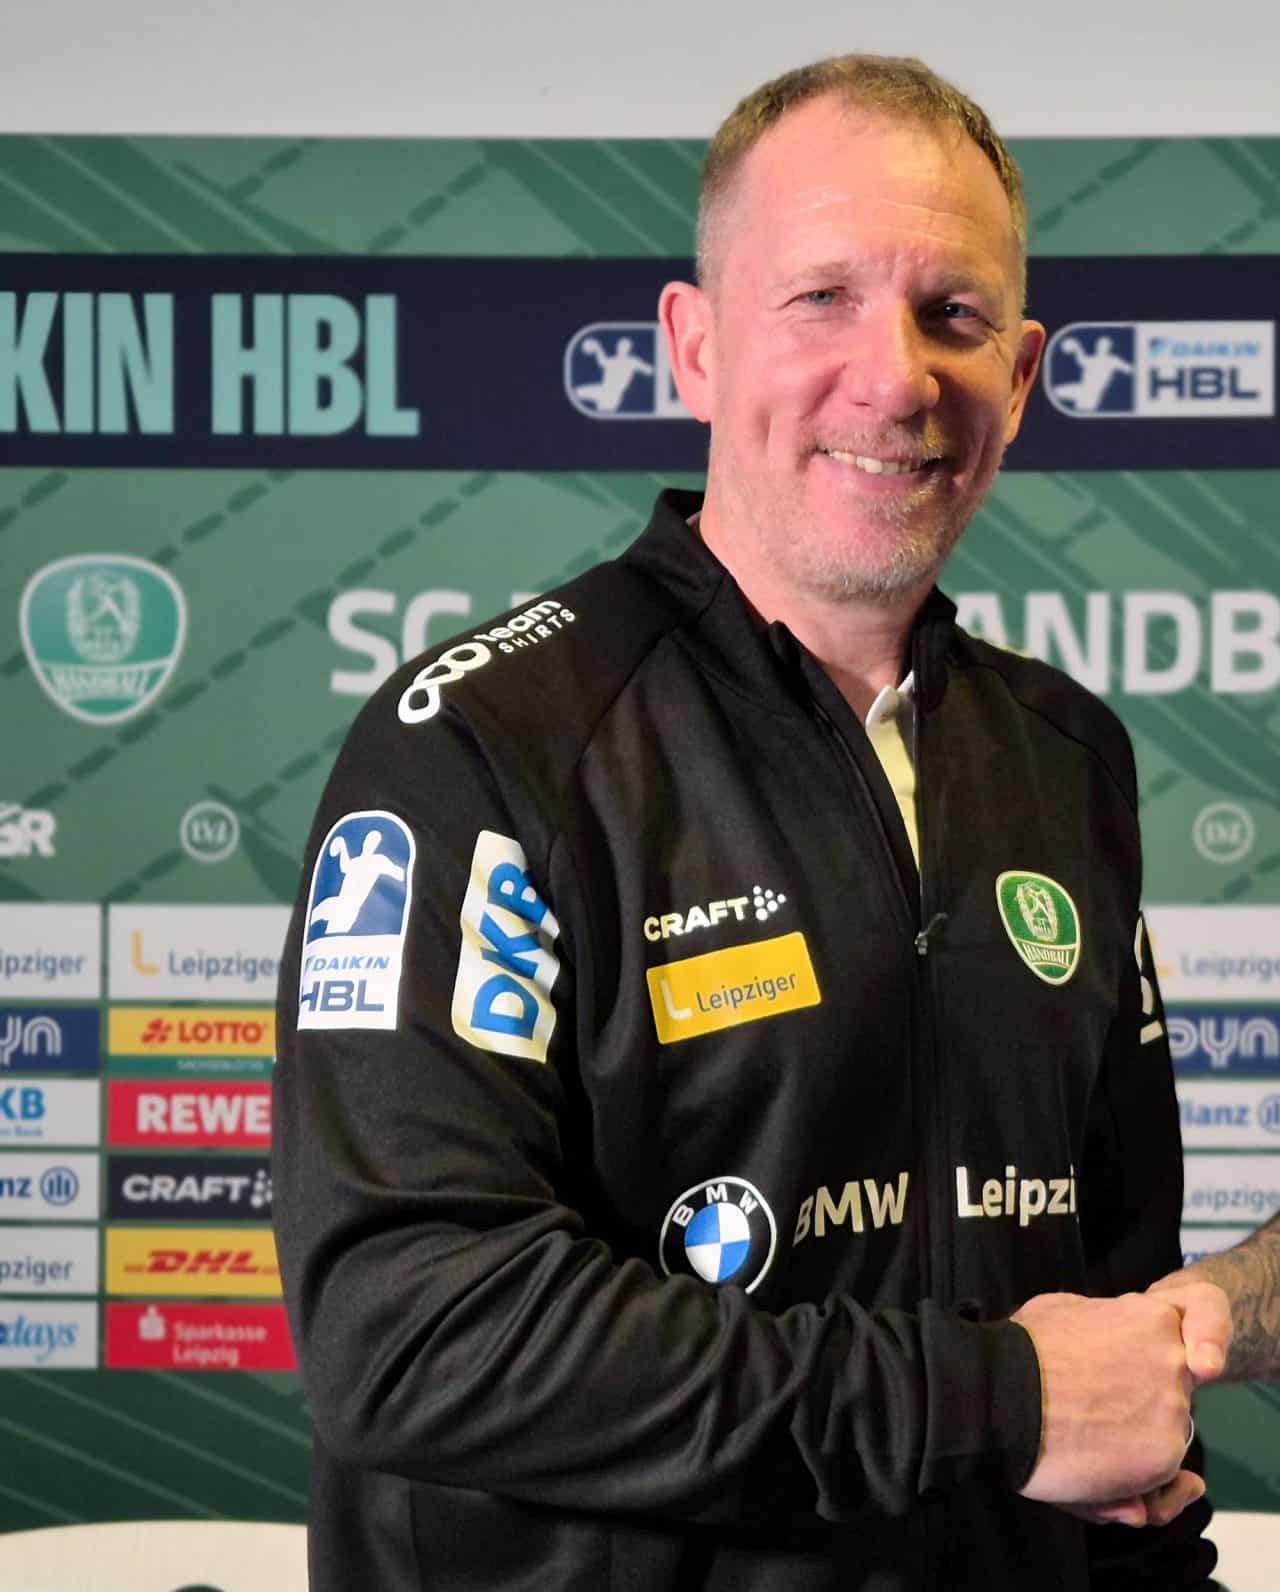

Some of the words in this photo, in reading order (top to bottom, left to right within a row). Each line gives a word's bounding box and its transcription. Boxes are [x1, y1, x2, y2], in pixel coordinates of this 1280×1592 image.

[211, 293, 421, 436] HBL
[1149, 365, 1260, 400] HBL
[474, 599, 562, 643] team
[497, 608, 576, 654] SHIRTS
[643, 896, 749, 942] CRAFT
[312, 955, 391, 972] DAIKIN
[470, 862, 549, 1031] DKB
[696, 972, 797, 1013] Leipziger
[178, 1021, 263, 1044] LOTTO
[136, 1094, 272, 1134] REWE
[121, 1174, 250, 1203] CRAFT
[672, 1183, 758, 1228] BMW
[955, 1164, 1077, 1227] Leipzi
[146, 1250, 259, 1275] DHL
[173, 1322, 267, 1346] Sparkasse
[172, 1346, 240, 1367] Leipzig
